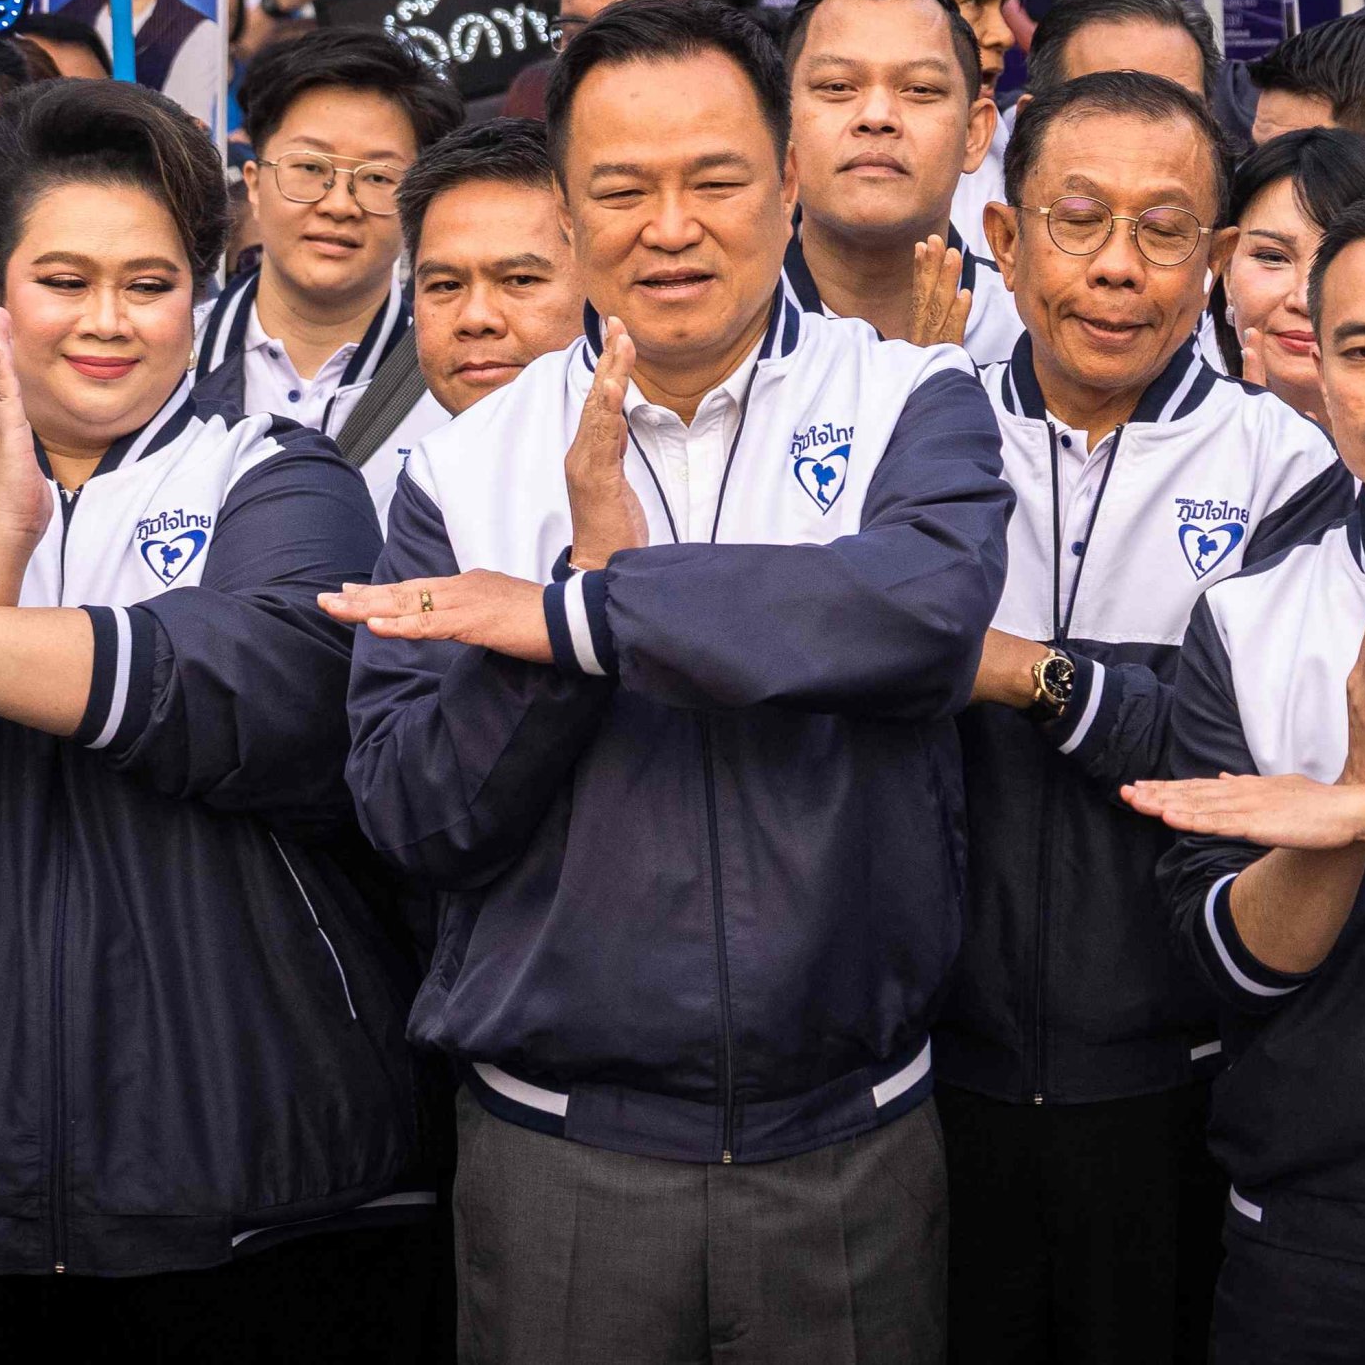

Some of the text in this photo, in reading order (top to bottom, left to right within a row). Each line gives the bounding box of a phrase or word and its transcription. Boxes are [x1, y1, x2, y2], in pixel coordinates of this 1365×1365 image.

[136, 508, 212, 541] ภูมิใจไทย
[1177, 500, 1250, 523] ภูมิใจไทย
